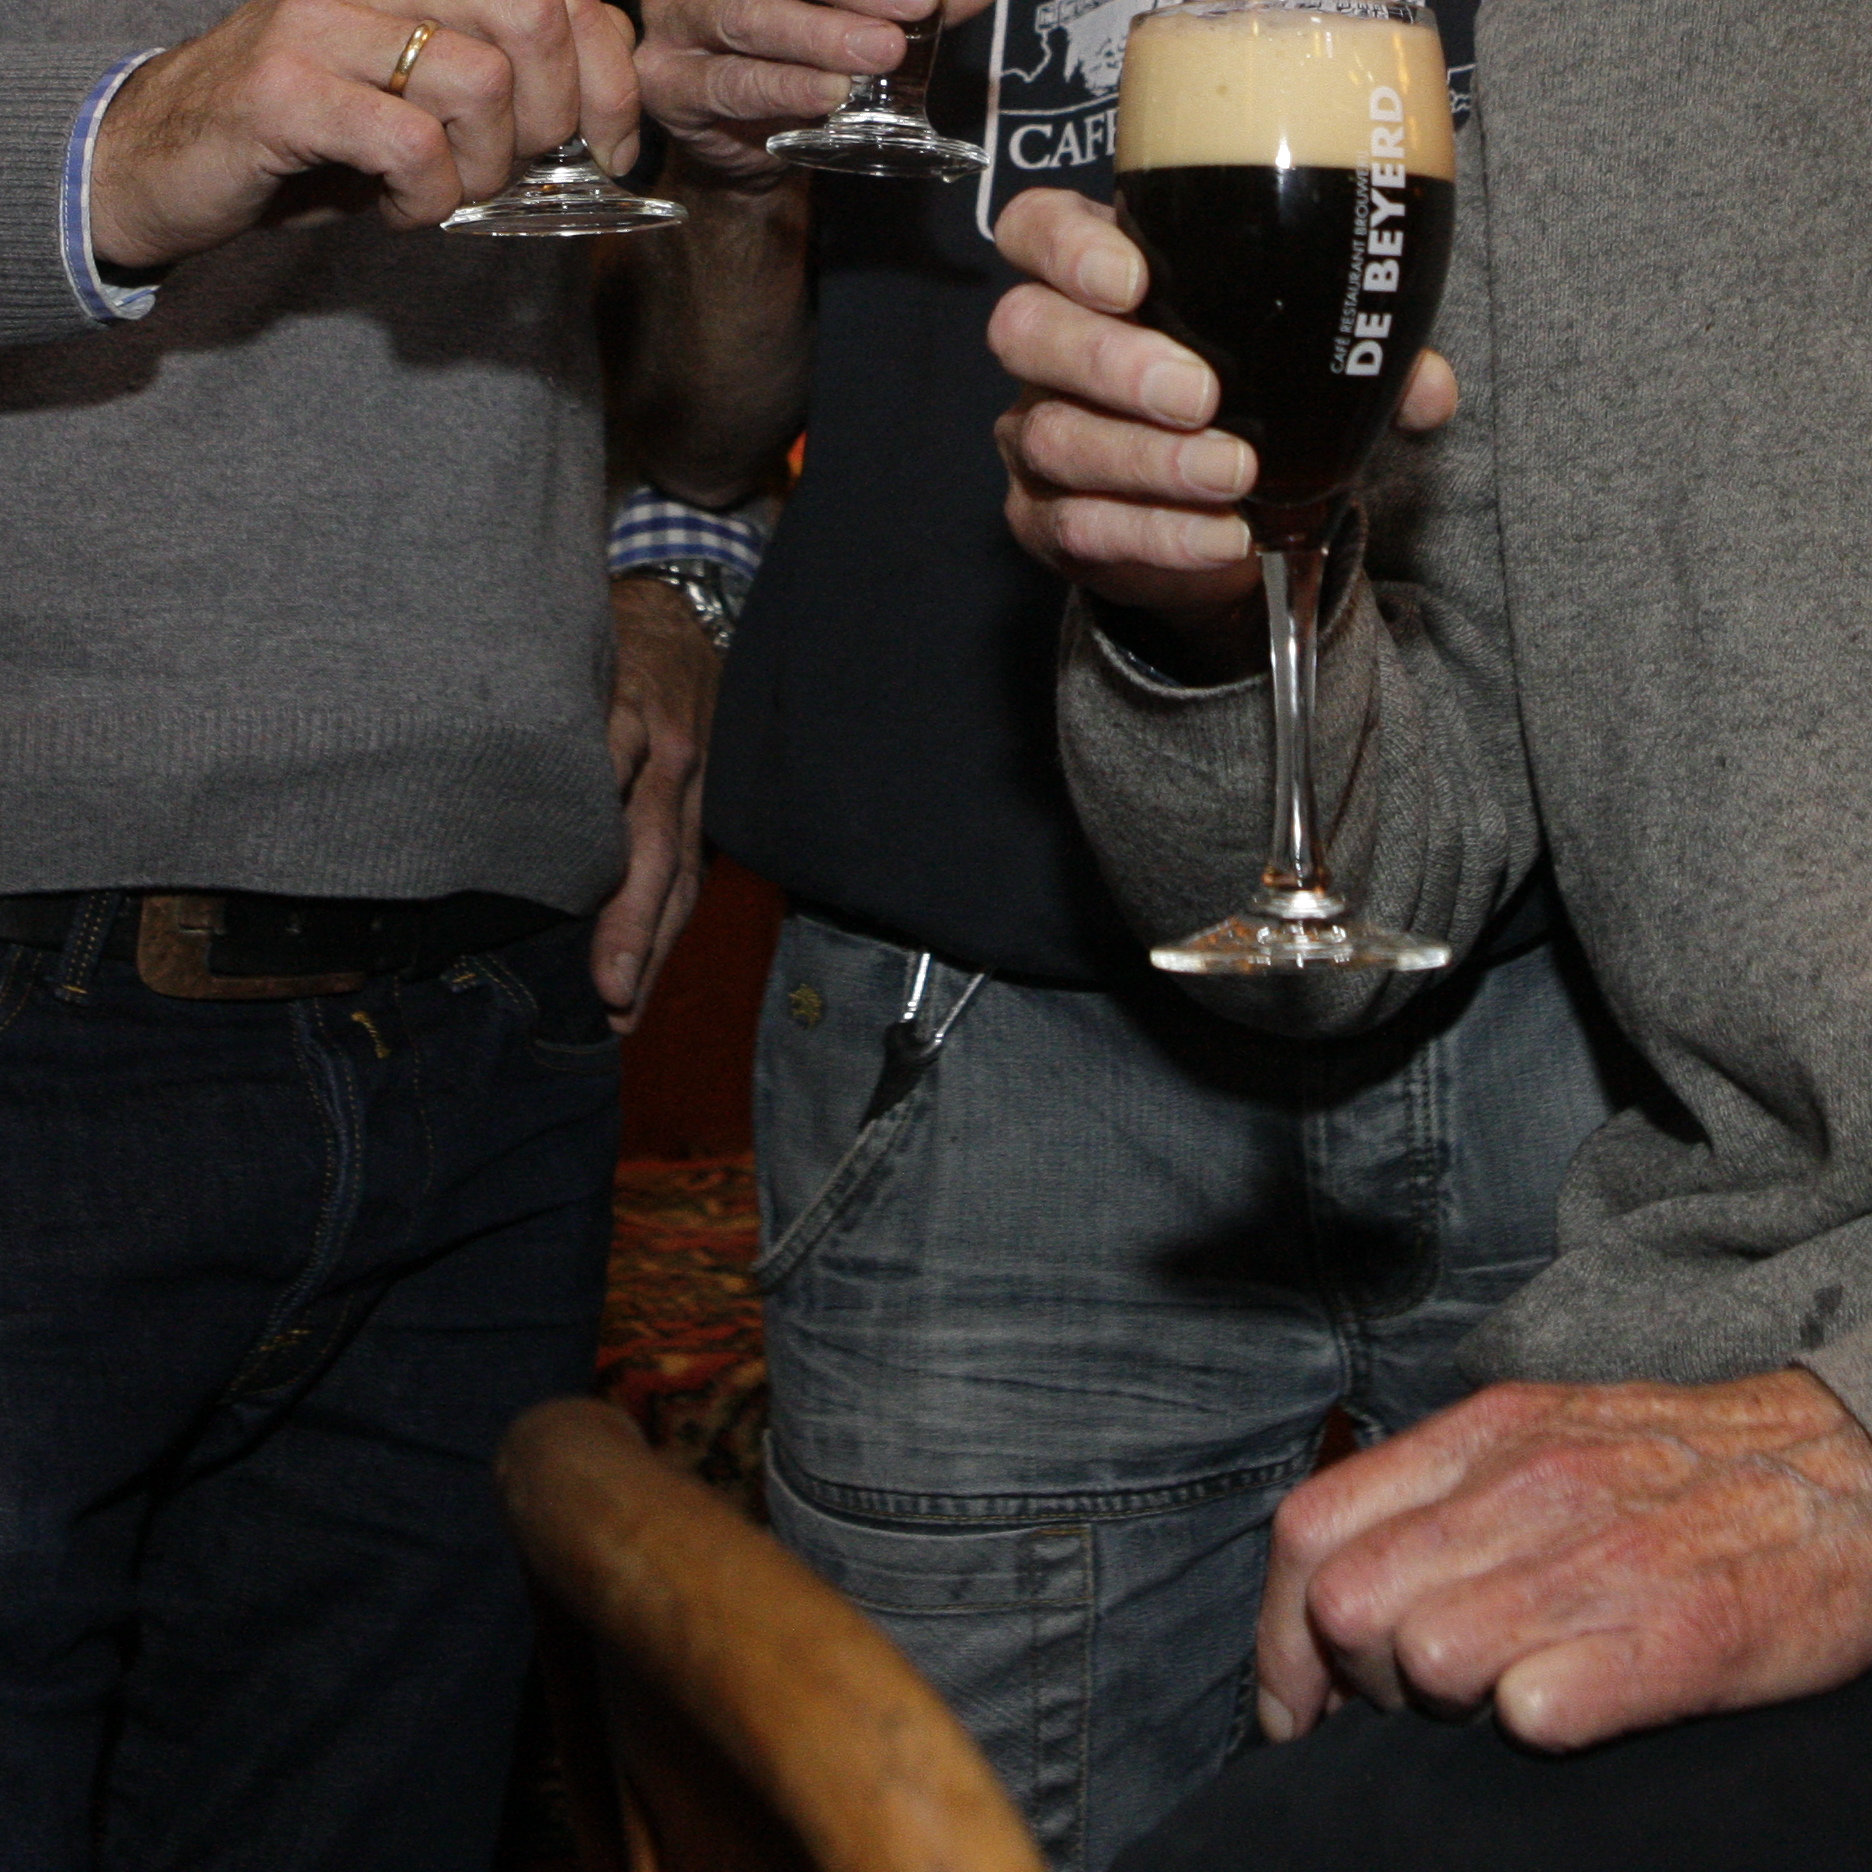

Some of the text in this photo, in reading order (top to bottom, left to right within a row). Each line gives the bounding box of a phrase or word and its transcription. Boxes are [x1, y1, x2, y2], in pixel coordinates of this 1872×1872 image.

[1339, 238, 1366, 335] RESTAURANT
[1345, 84, 1407, 377] DE BEYERD
